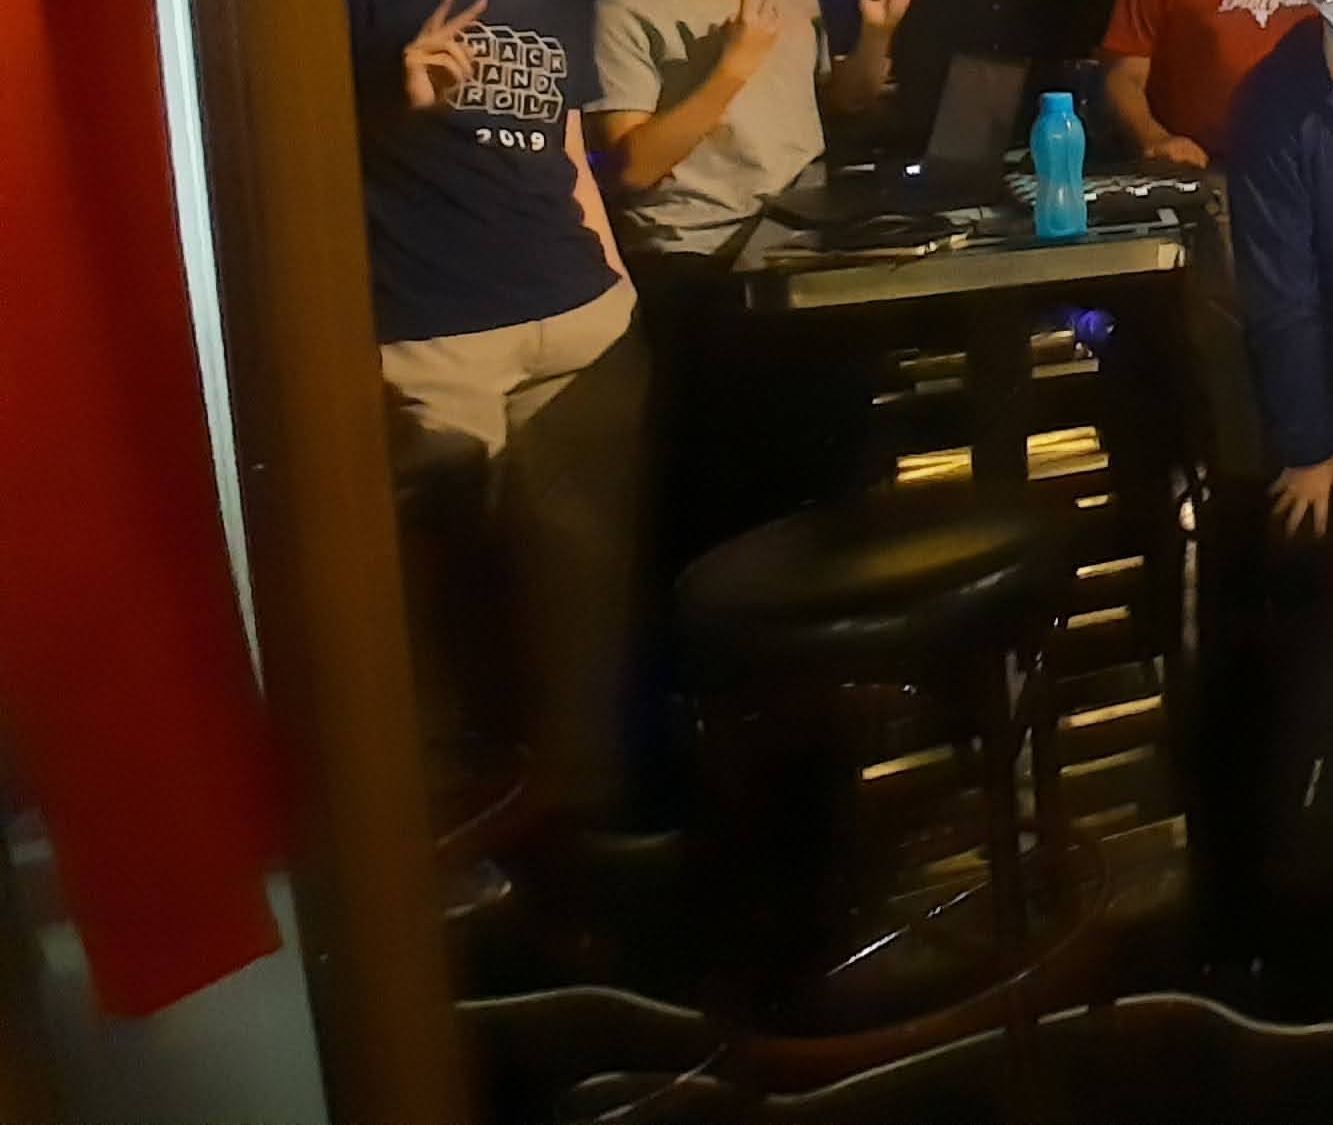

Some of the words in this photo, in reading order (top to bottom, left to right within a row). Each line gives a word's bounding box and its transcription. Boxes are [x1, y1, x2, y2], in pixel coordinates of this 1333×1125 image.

[471, 38, 563, 72] HACK
[487, 67, 551, 94] AND
[475, 127, 546, 152] 2019
